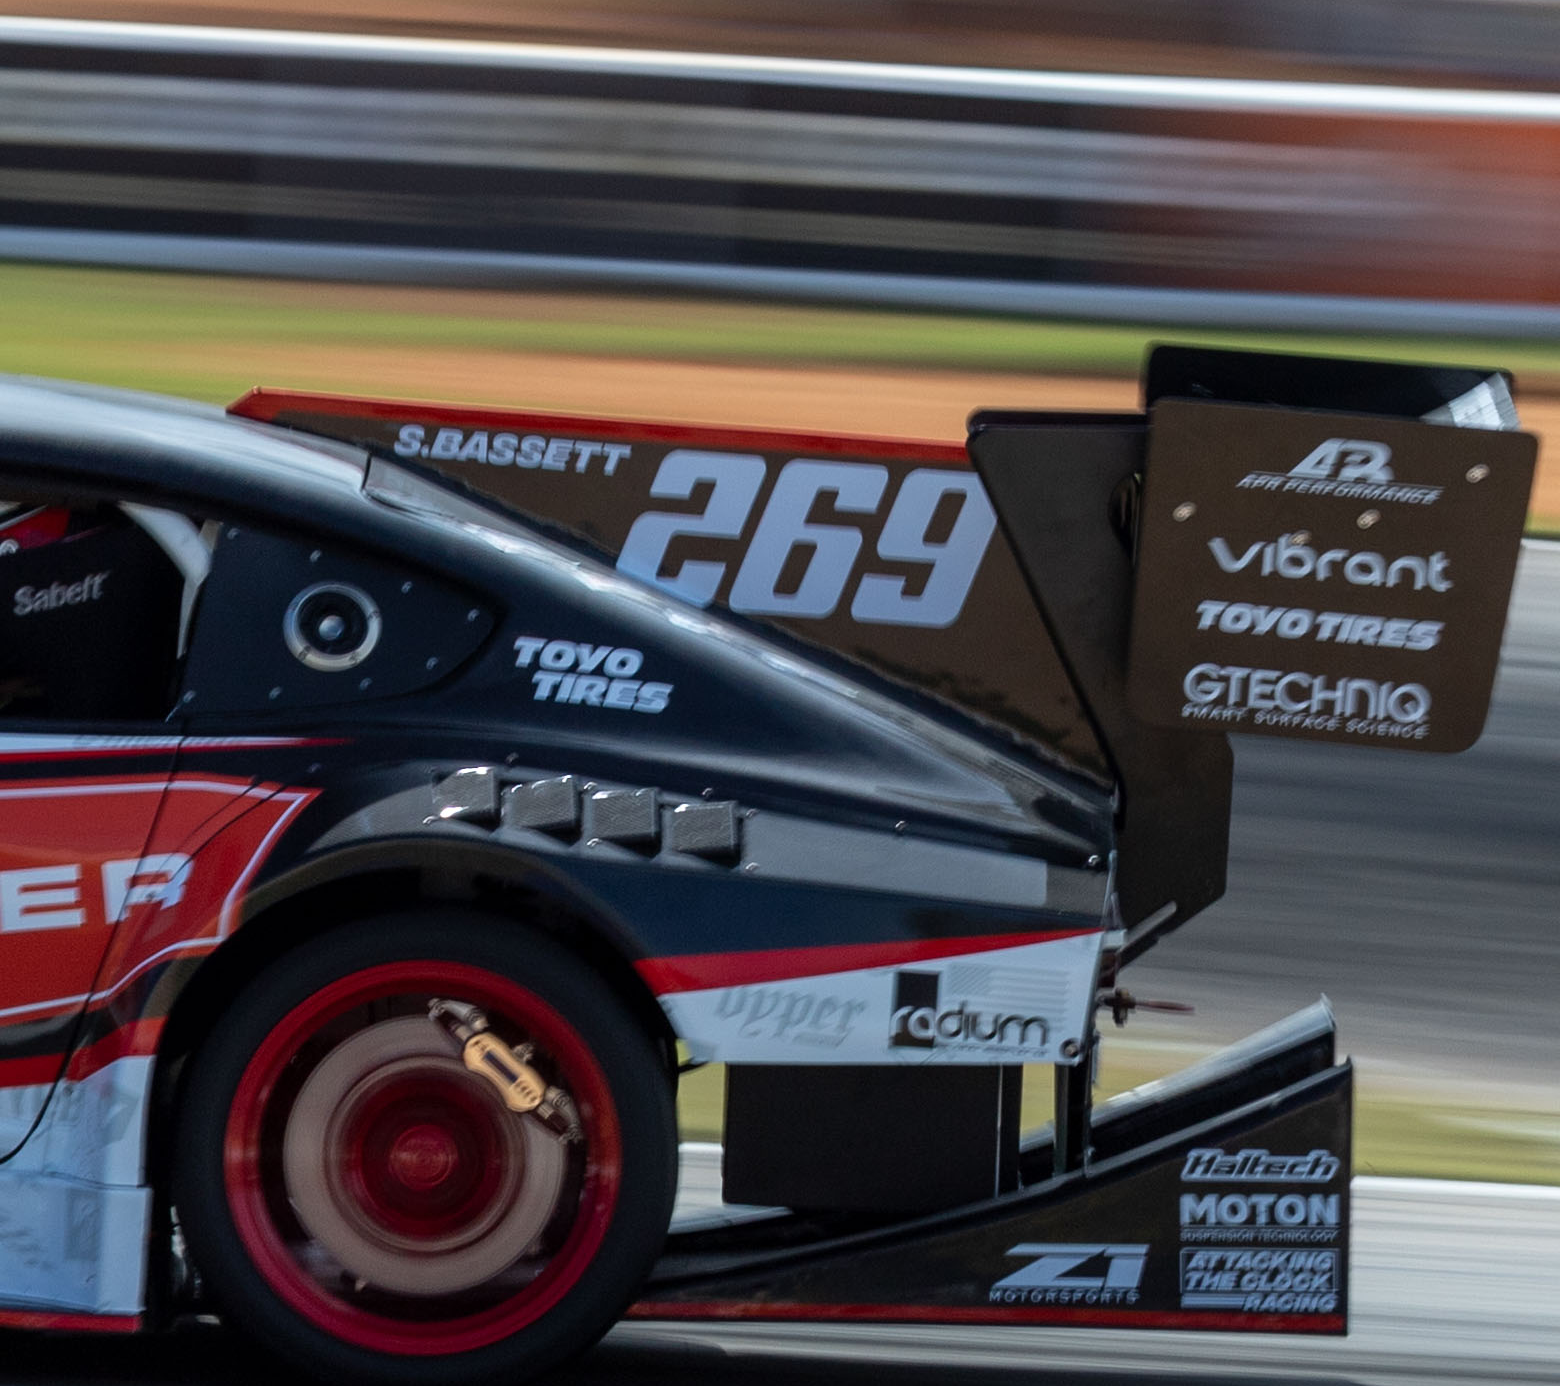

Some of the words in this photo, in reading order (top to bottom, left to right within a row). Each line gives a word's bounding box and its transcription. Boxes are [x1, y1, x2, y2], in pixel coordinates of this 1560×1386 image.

[393, 424, 632, 476] S.BASSETT
[1282, 479, 1445, 506] PERFORMANCE
[616, 450, 998, 630] 269
[1208, 533, 1453, 593] vibrant
[13, 569, 111, 617] Sabelt
[1196, 600, 1315, 640] TOYO
[1315, 612, 1446, 651] TIRES
[513, 636, 644, 678] TOYO
[531, 669, 674, 714] TIRES
[1183, 663, 1433, 725] GTECHNIQ
[1182, 703, 1249, 721] SMART
[1254, 711, 1344, 732] SURFACE
[1345, 719, 1431, 740] SCIENCE
[891, 999, 1050, 1049] radium
[1182, 1148, 1341, 1183] Haltech
[1181, 1193, 1341, 1227] MOTON
[1181, 1227, 1255, 1243] SUSPENSION
[1257, 1228, 1342, 1244] TECHNOLOGY
[990, 1242, 1151, 1290] Z1
[1185, 1249, 1334, 1272] ATTACKING
[1185, 1270, 1240, 1291] THE
[1240, 1272, 1332, 1292] CLOCK
[988, 1288, 1141, 1305] MOTORSPORTS
[1242, 1291, 1340, 1313] RACING
